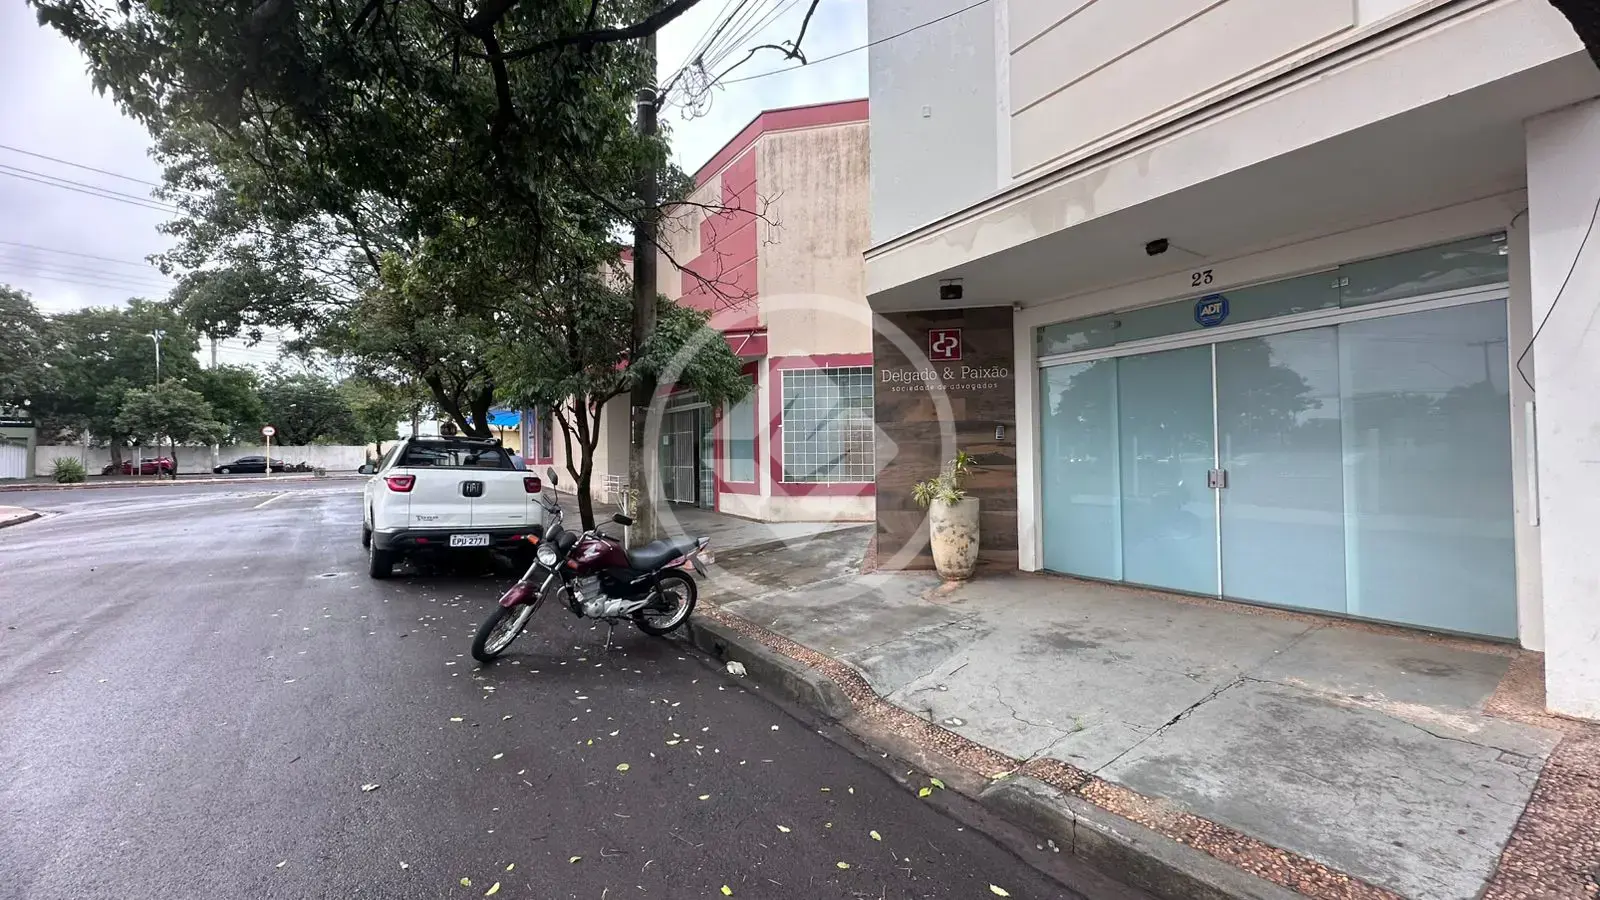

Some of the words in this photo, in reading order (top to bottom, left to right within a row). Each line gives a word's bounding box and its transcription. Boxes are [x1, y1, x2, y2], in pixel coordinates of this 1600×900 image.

[1191, 269, 1213, 288] 23
[1201, 302, 1222, 316] ADT
[881, 368, 938, 384] Delgado
[943, 366, 954, 380] &
[961, 365, 1008, 380] Paixão
[892, 384, 934, 392] sociedade
[950, 382, 998, 391] advogados
[466, 482, 481, 493] FIAT
